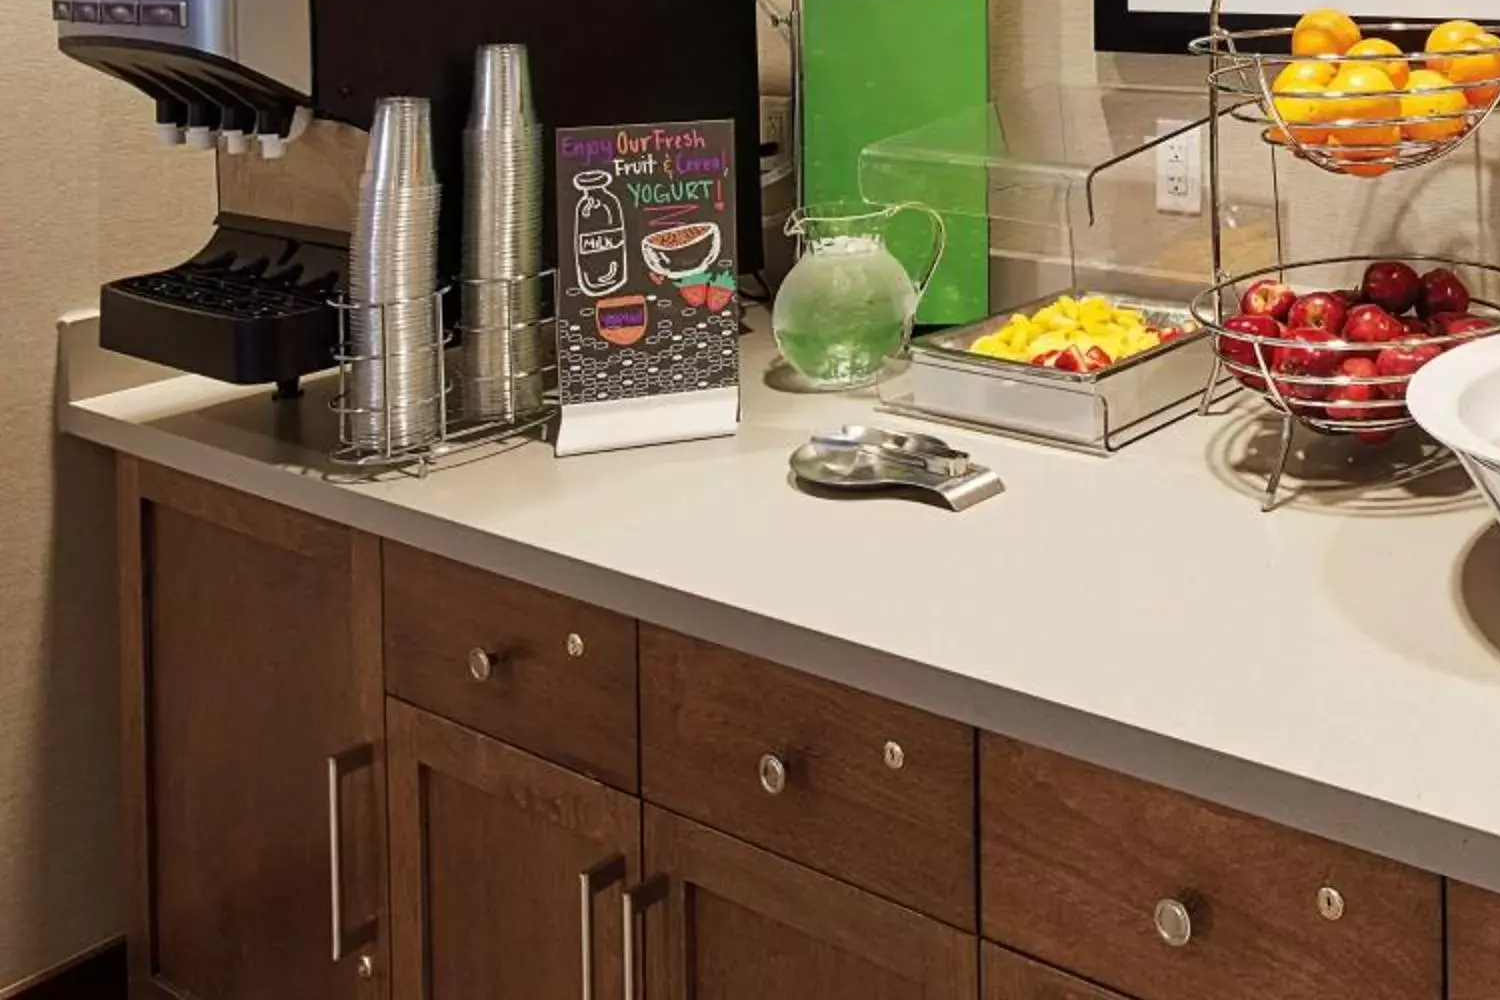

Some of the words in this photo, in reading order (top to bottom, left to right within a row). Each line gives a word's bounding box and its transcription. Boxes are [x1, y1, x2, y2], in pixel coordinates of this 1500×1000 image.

[561, 136, 613, 166] Enjoy
[616, 130, 652, 153] Our
[652, 128, 706, 149] Fresh
[613, 155, 659, 176] Fruit
